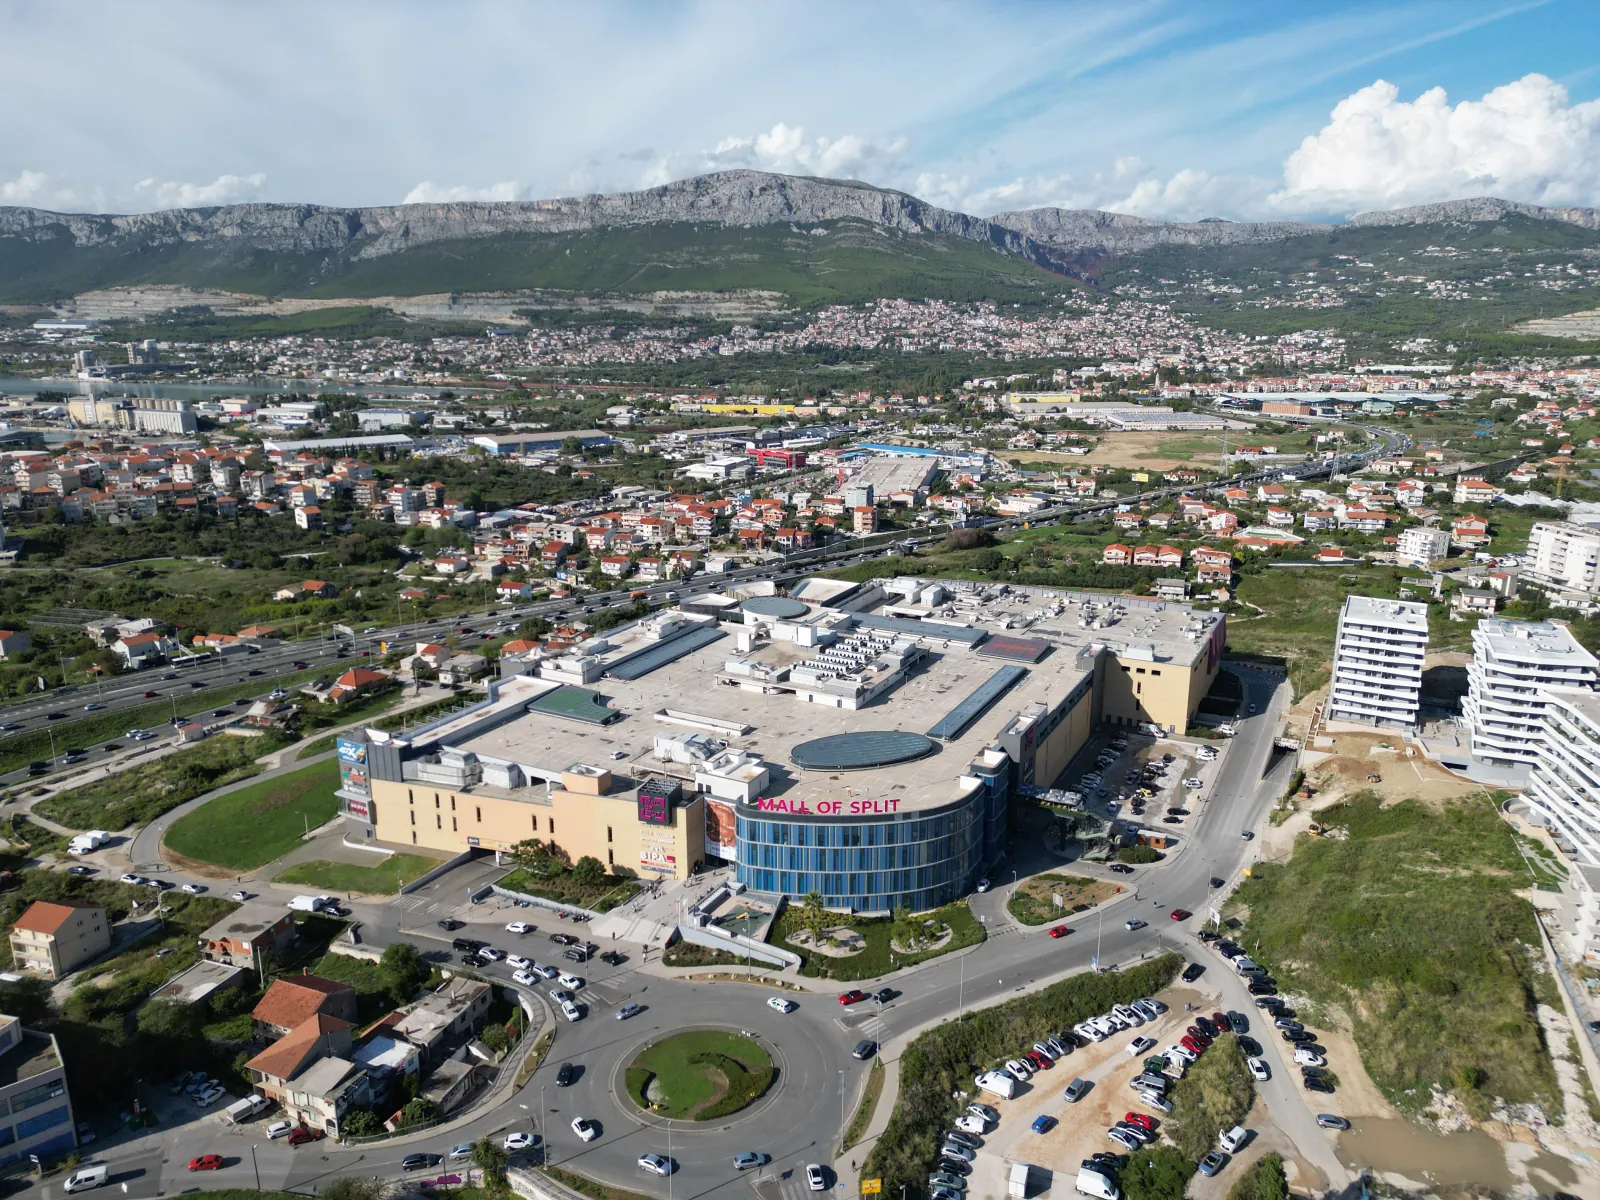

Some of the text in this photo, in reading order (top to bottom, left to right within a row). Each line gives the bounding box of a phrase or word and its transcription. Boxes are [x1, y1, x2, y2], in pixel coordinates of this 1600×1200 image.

[757, 796, 901, 814] MALL OF SPLIT
[640, 851, 667, 862] BIPA
